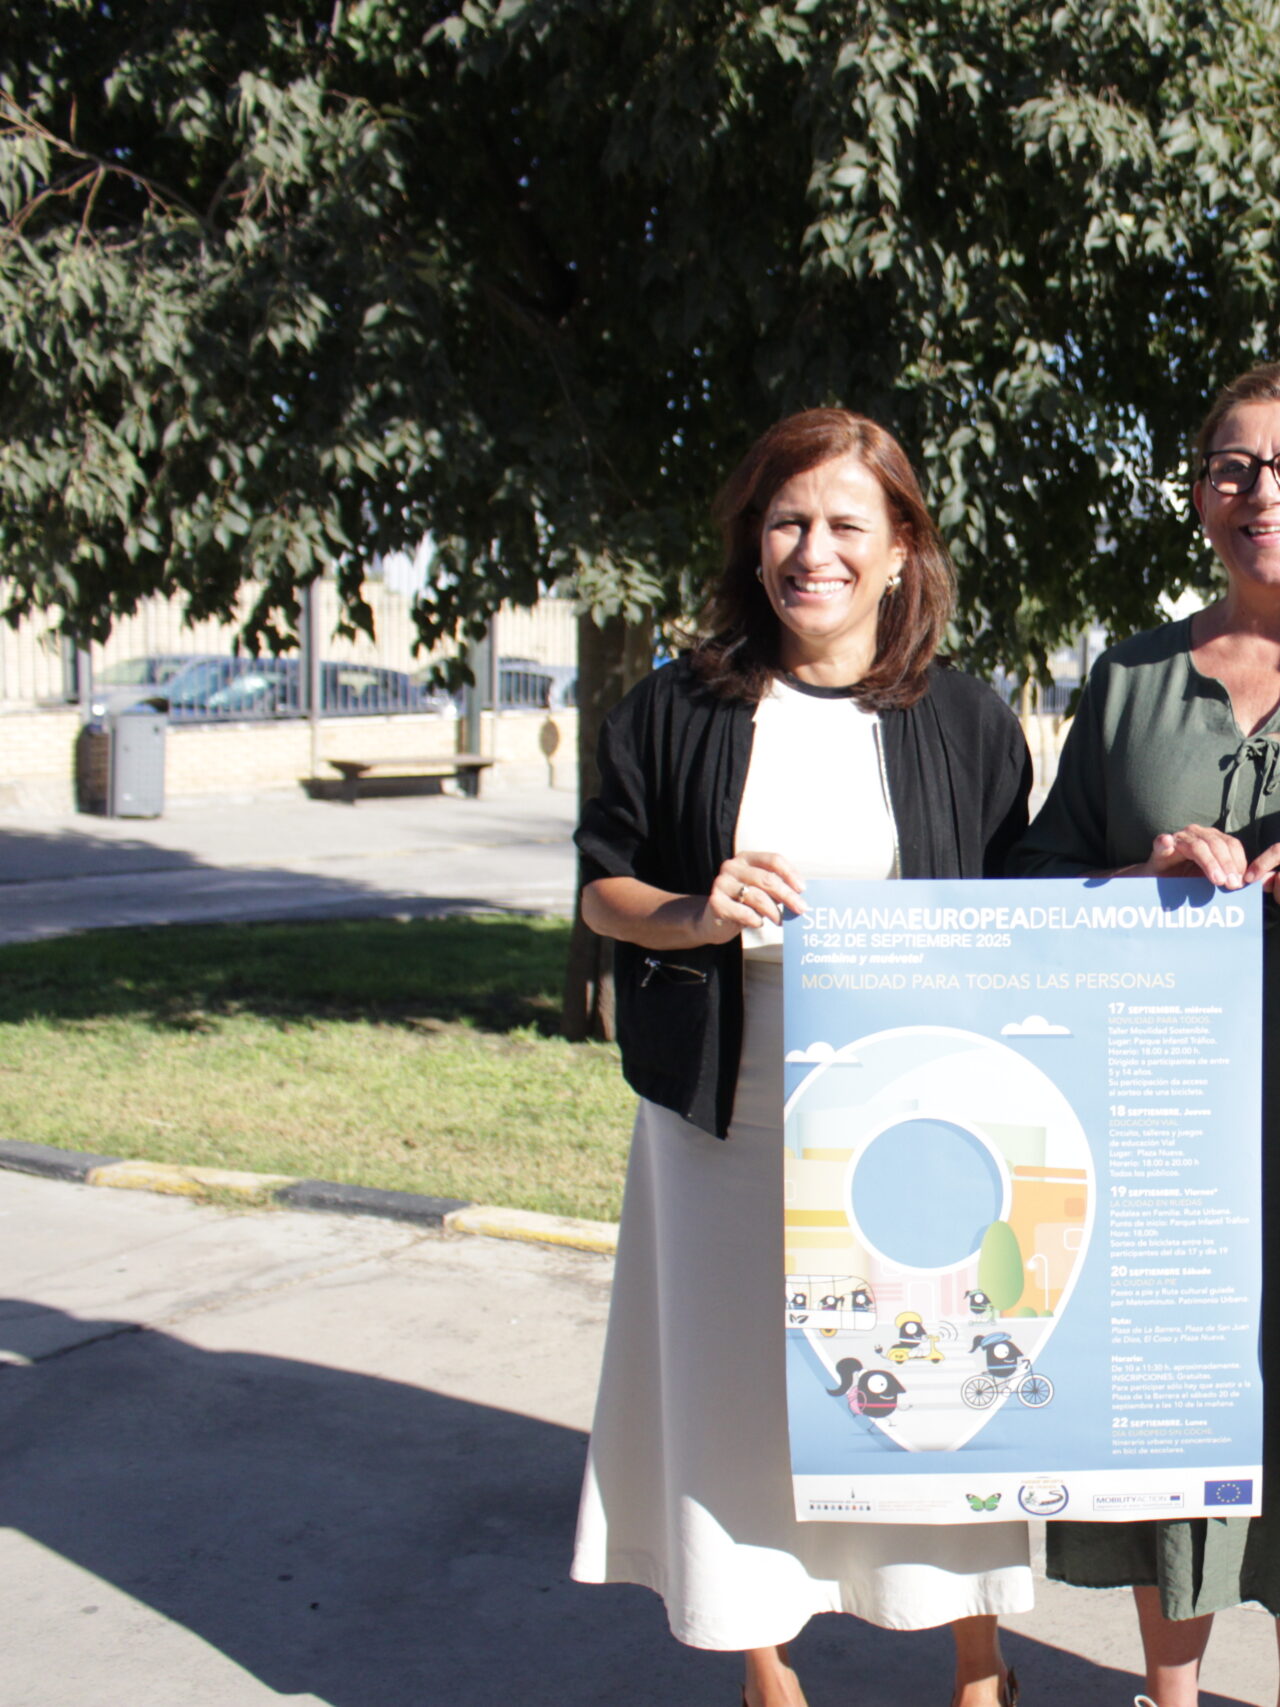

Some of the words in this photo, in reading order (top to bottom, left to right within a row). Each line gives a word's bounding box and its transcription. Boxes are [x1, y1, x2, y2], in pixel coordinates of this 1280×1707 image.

[803, 934, 841, 947] 16-22
[845, 934, 866, 947] DE
[871, 934, 971, 947] SEPTIEMBRE
[976, 934, 1011, 947] 2025
[801, 953, 856, 965] ¡Combina
[859, 956, 866, 965] y
[870, 953, 924, 964] muévete!
[802, 974, 906, 990] MOVILIDAD
[912, 974, 960, 989] PARA
[966, 974, 1030, 989] TODAS
[1037, 973, 1069, 989] LAS
[1076, 973, 1175, 988] PERSONAS
